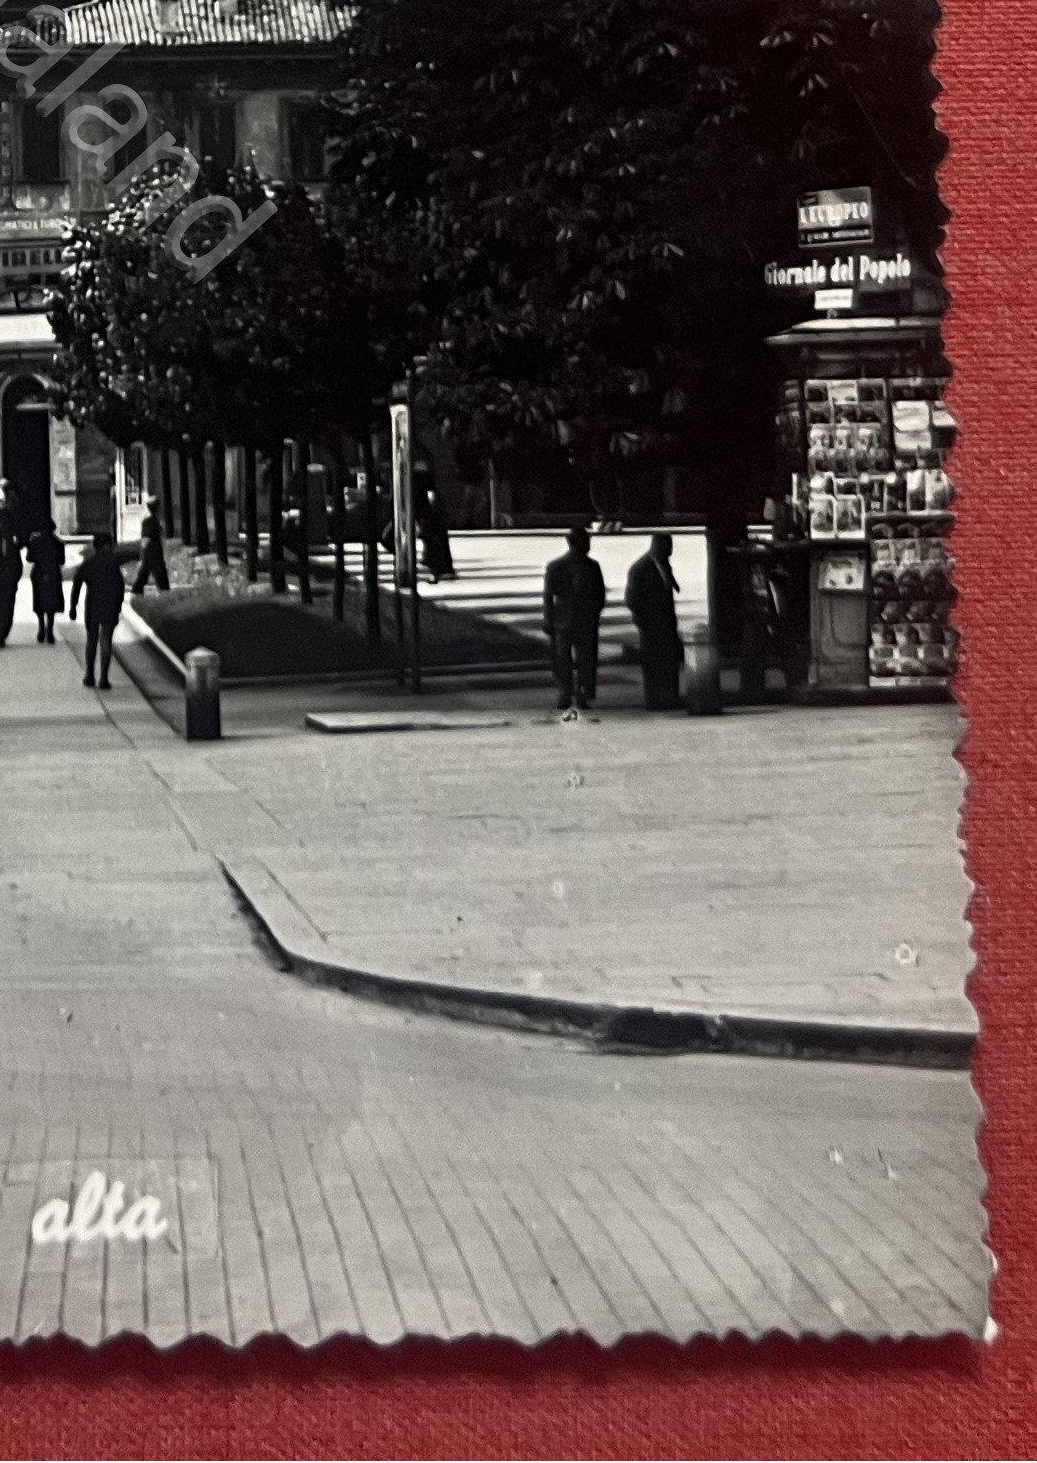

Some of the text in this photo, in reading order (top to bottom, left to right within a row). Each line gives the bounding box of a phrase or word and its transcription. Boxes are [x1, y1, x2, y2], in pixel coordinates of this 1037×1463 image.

[764, 253, 911, 285] Giornale del Popolo
